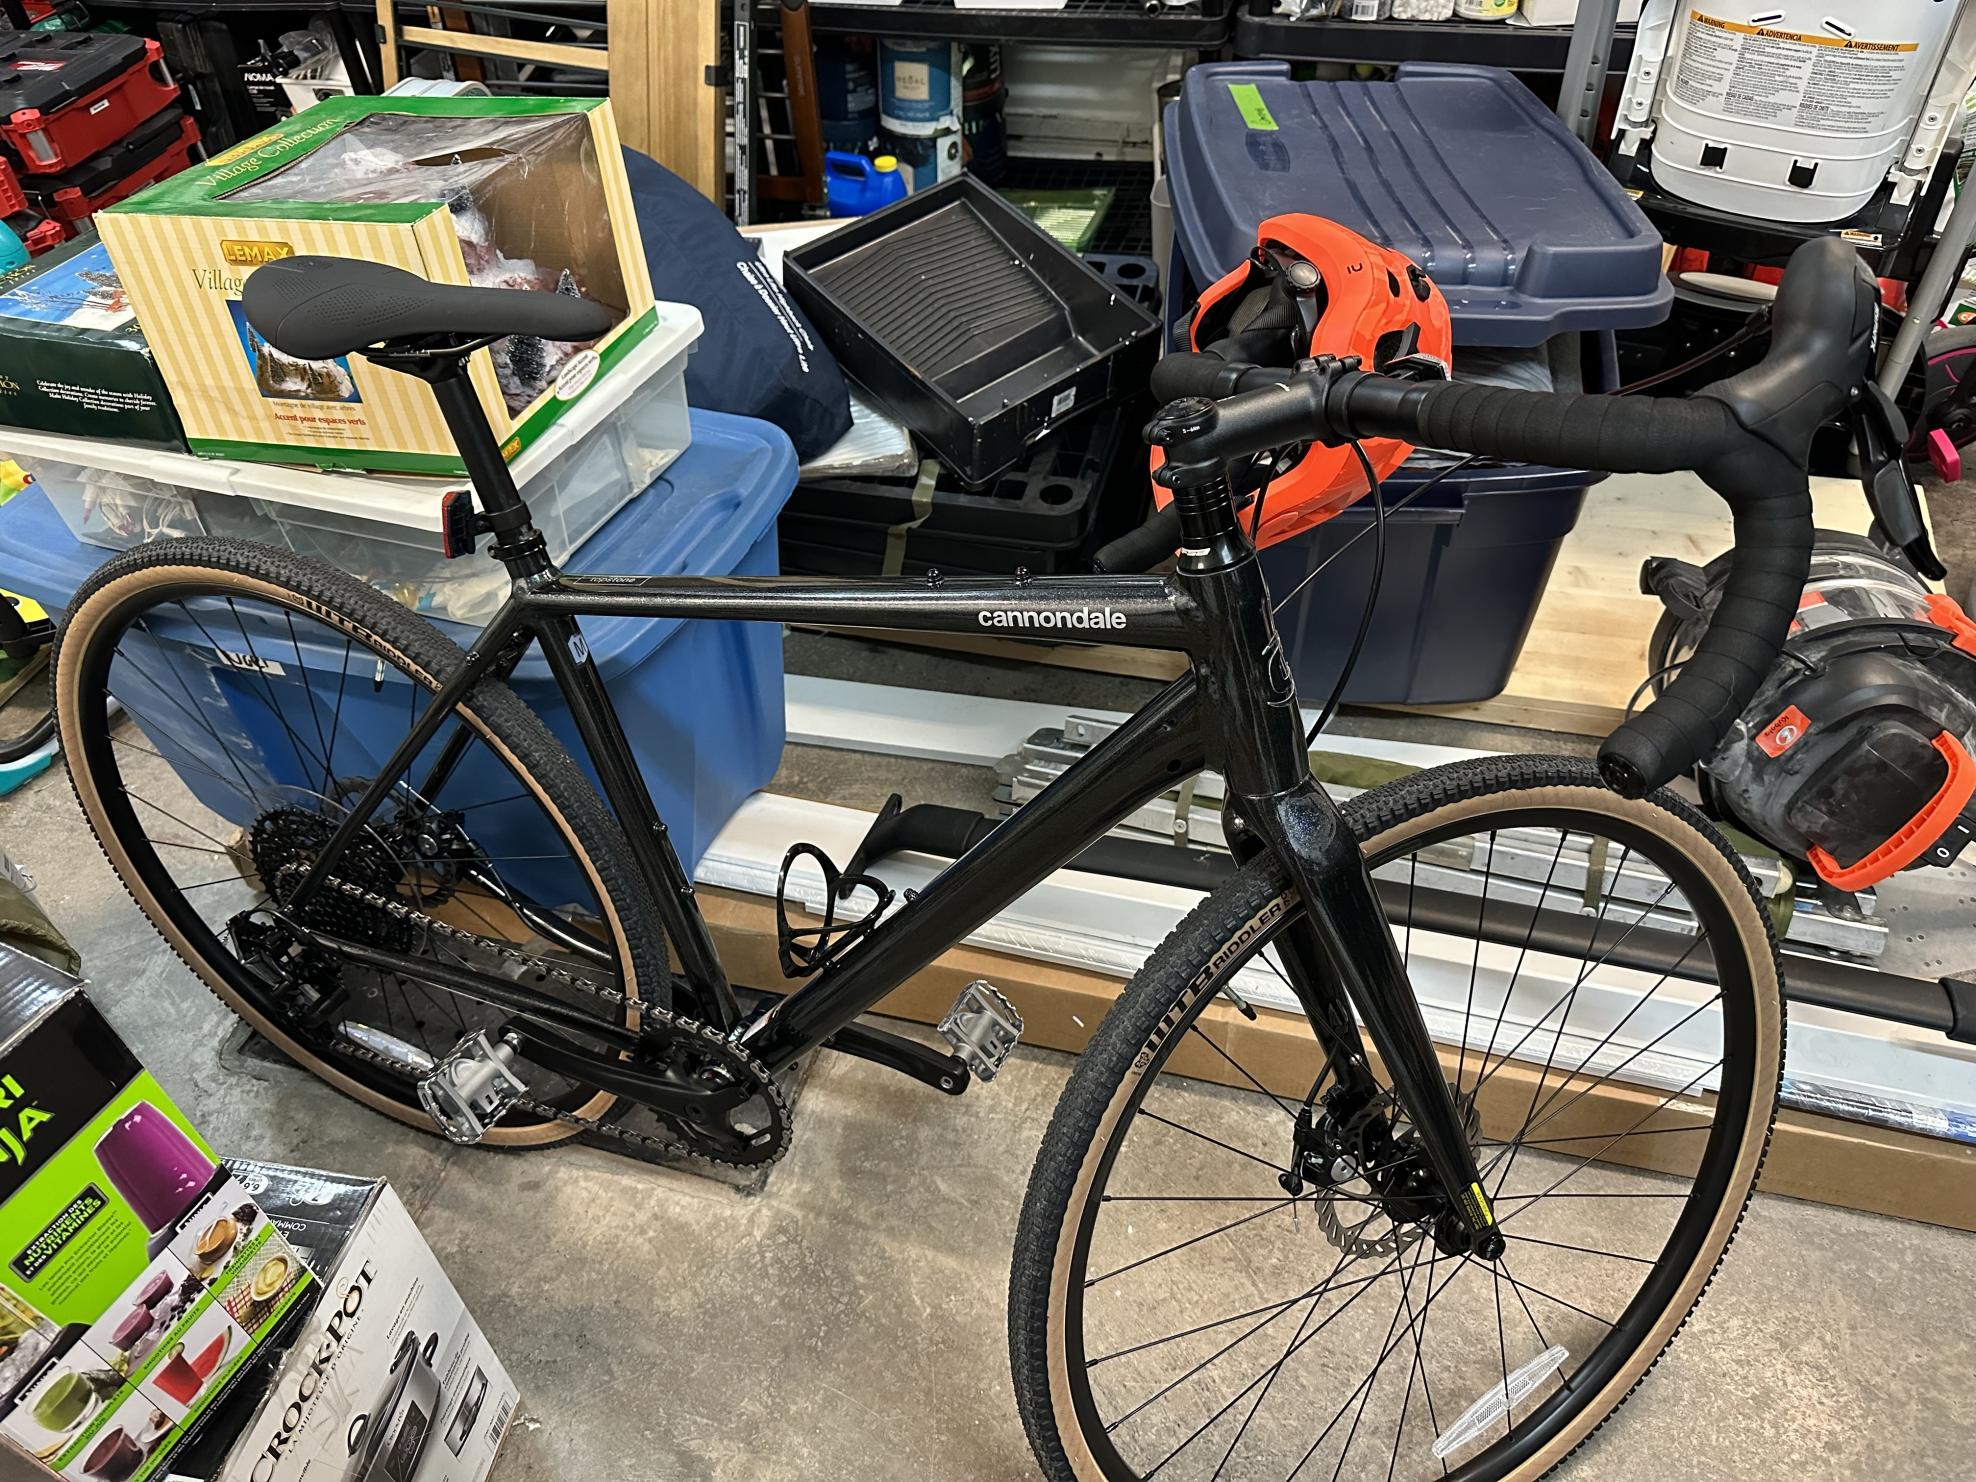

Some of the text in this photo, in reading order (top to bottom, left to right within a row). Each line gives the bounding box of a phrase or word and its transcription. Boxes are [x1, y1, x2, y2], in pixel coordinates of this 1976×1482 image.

[1704, 18, 1725, 29] WARNING
[1765, 30, 1801, 41] ADVERTENCIA
[1853, 42, 1900, 51] AVERTISSEMENT
[198, 118, 339, 186] Village Collection
[225, 245, 289, 261] LEMAX
[192, 268, 245, 296] Villag
[274, 413, 367, 426] Accent pour espaces verts
[978, 606, 1127, 629] cannondale
[573, 637, 586, 658] M
[1765, 715, 1790, 737] Kubota
[1213, 904, 1282, 971] RIDDLER
[23, 1197, 93, 1266] NUTRIMENTS
[26, 1199, 82, 1255] EXTRACTION DES
[270, 1218, 307, 1232] COMMA
[25, 1199, 101, 1275] ET DES VITAMINES
